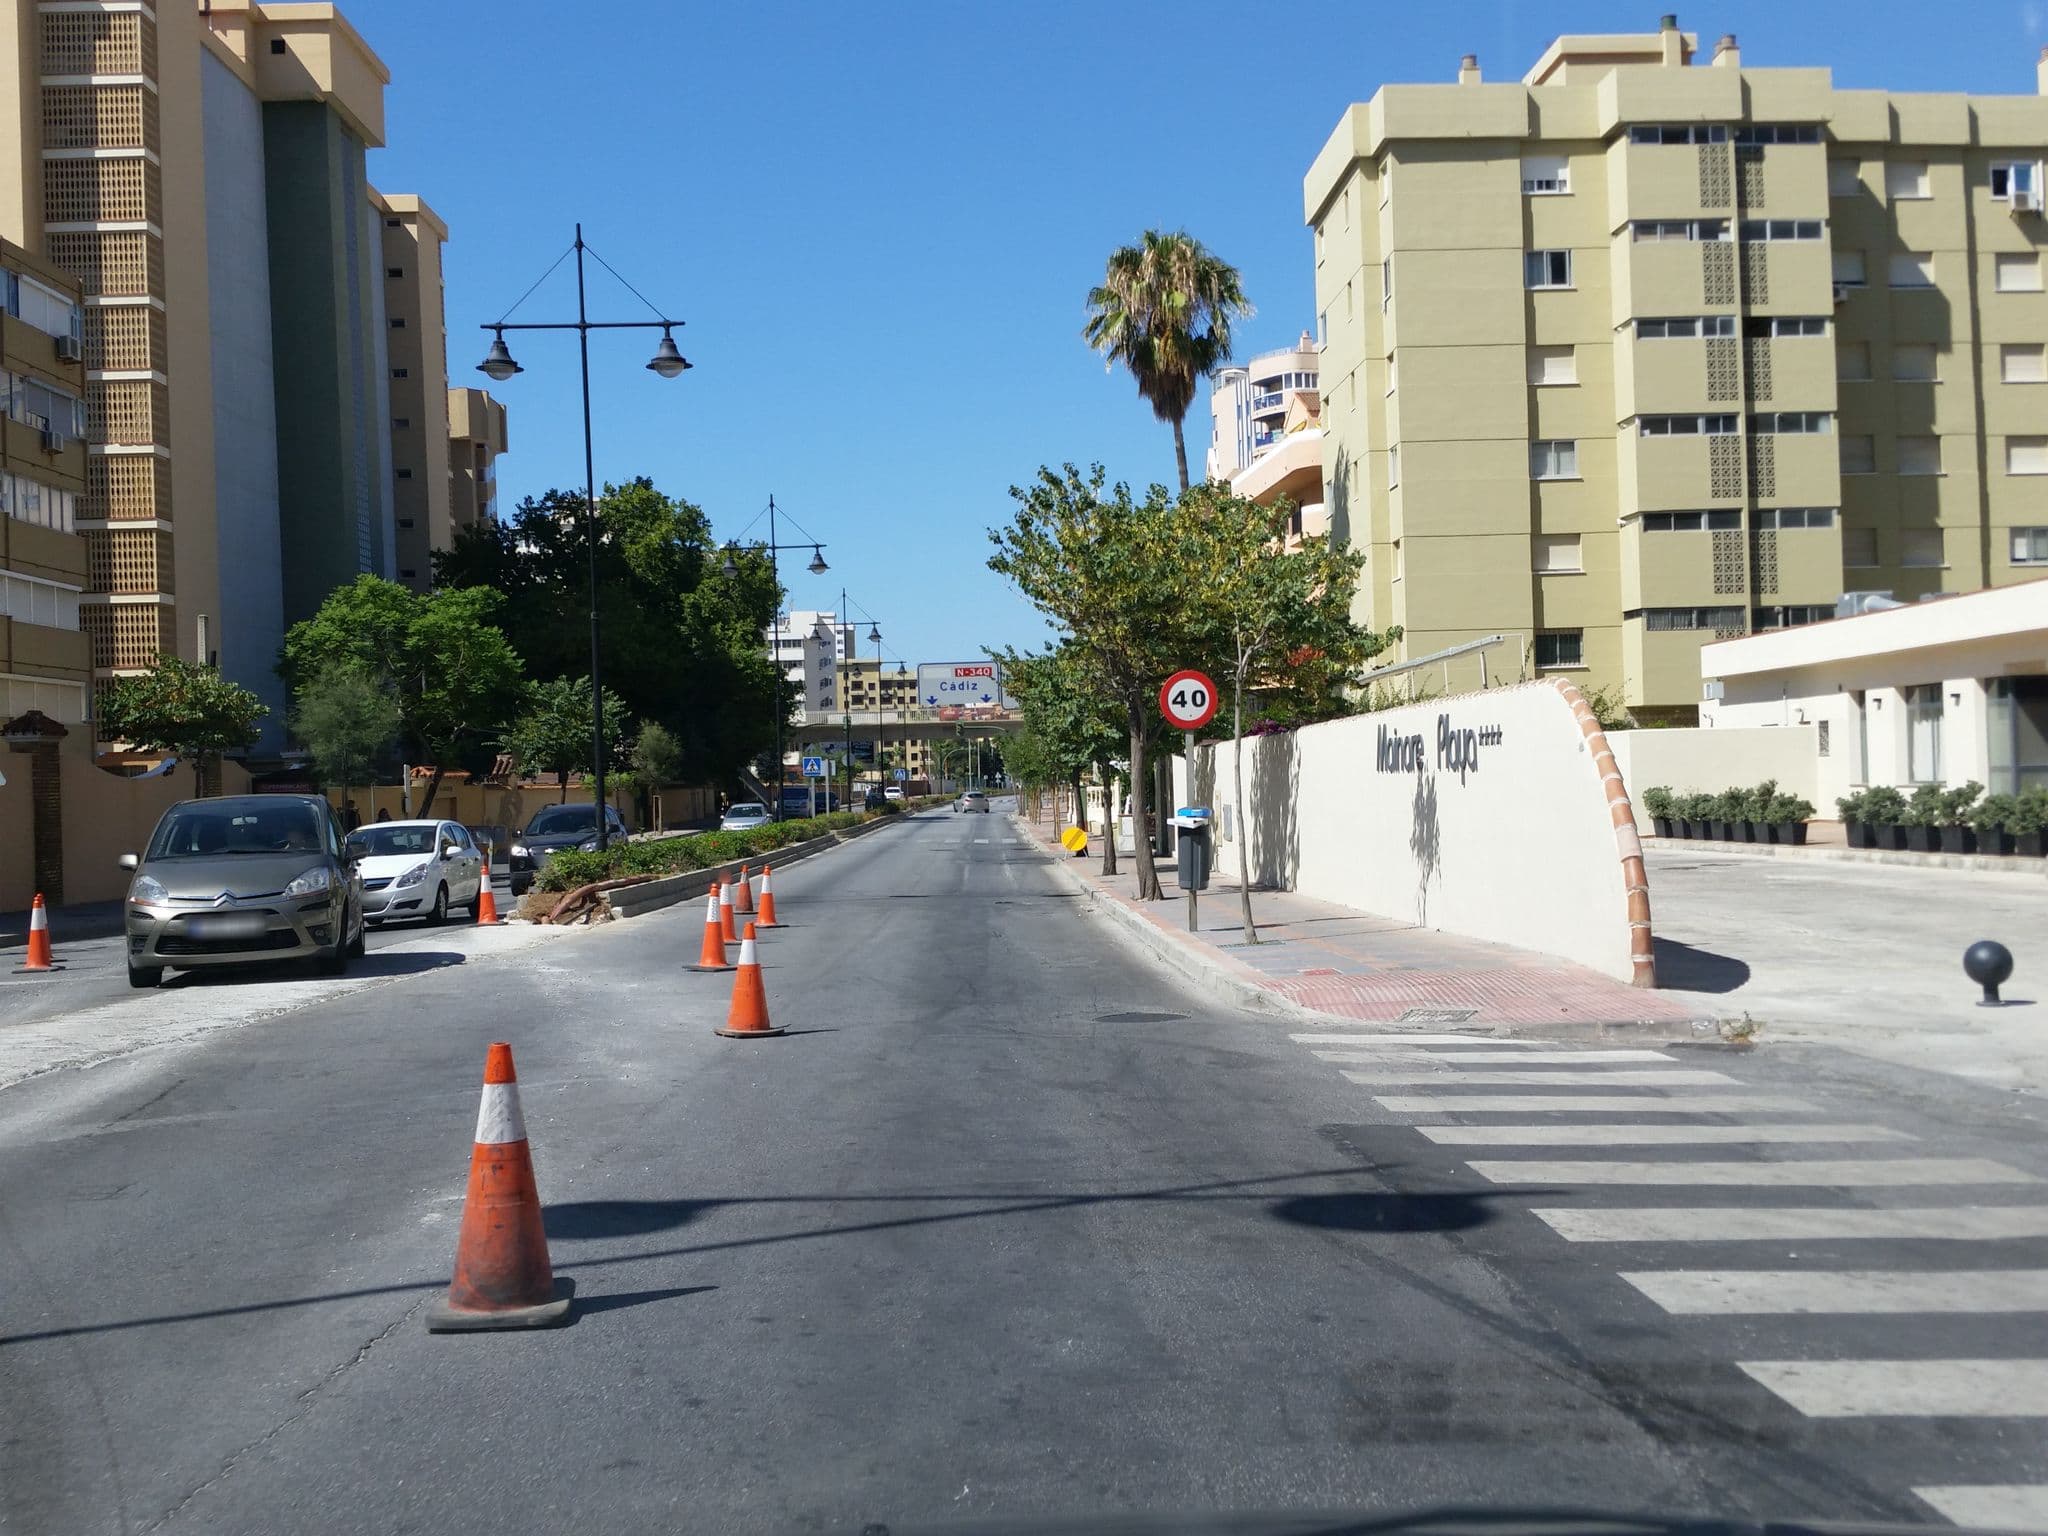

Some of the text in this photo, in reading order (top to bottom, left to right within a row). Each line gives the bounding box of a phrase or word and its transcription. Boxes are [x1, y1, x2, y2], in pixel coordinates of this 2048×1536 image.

[956, 668, 990, 676] N-340
[940, 680, 978, 691] Cádiz
[1172, 690, 1206, 708] 40
[1377, 713, 1478, 788] Mainare Playa
